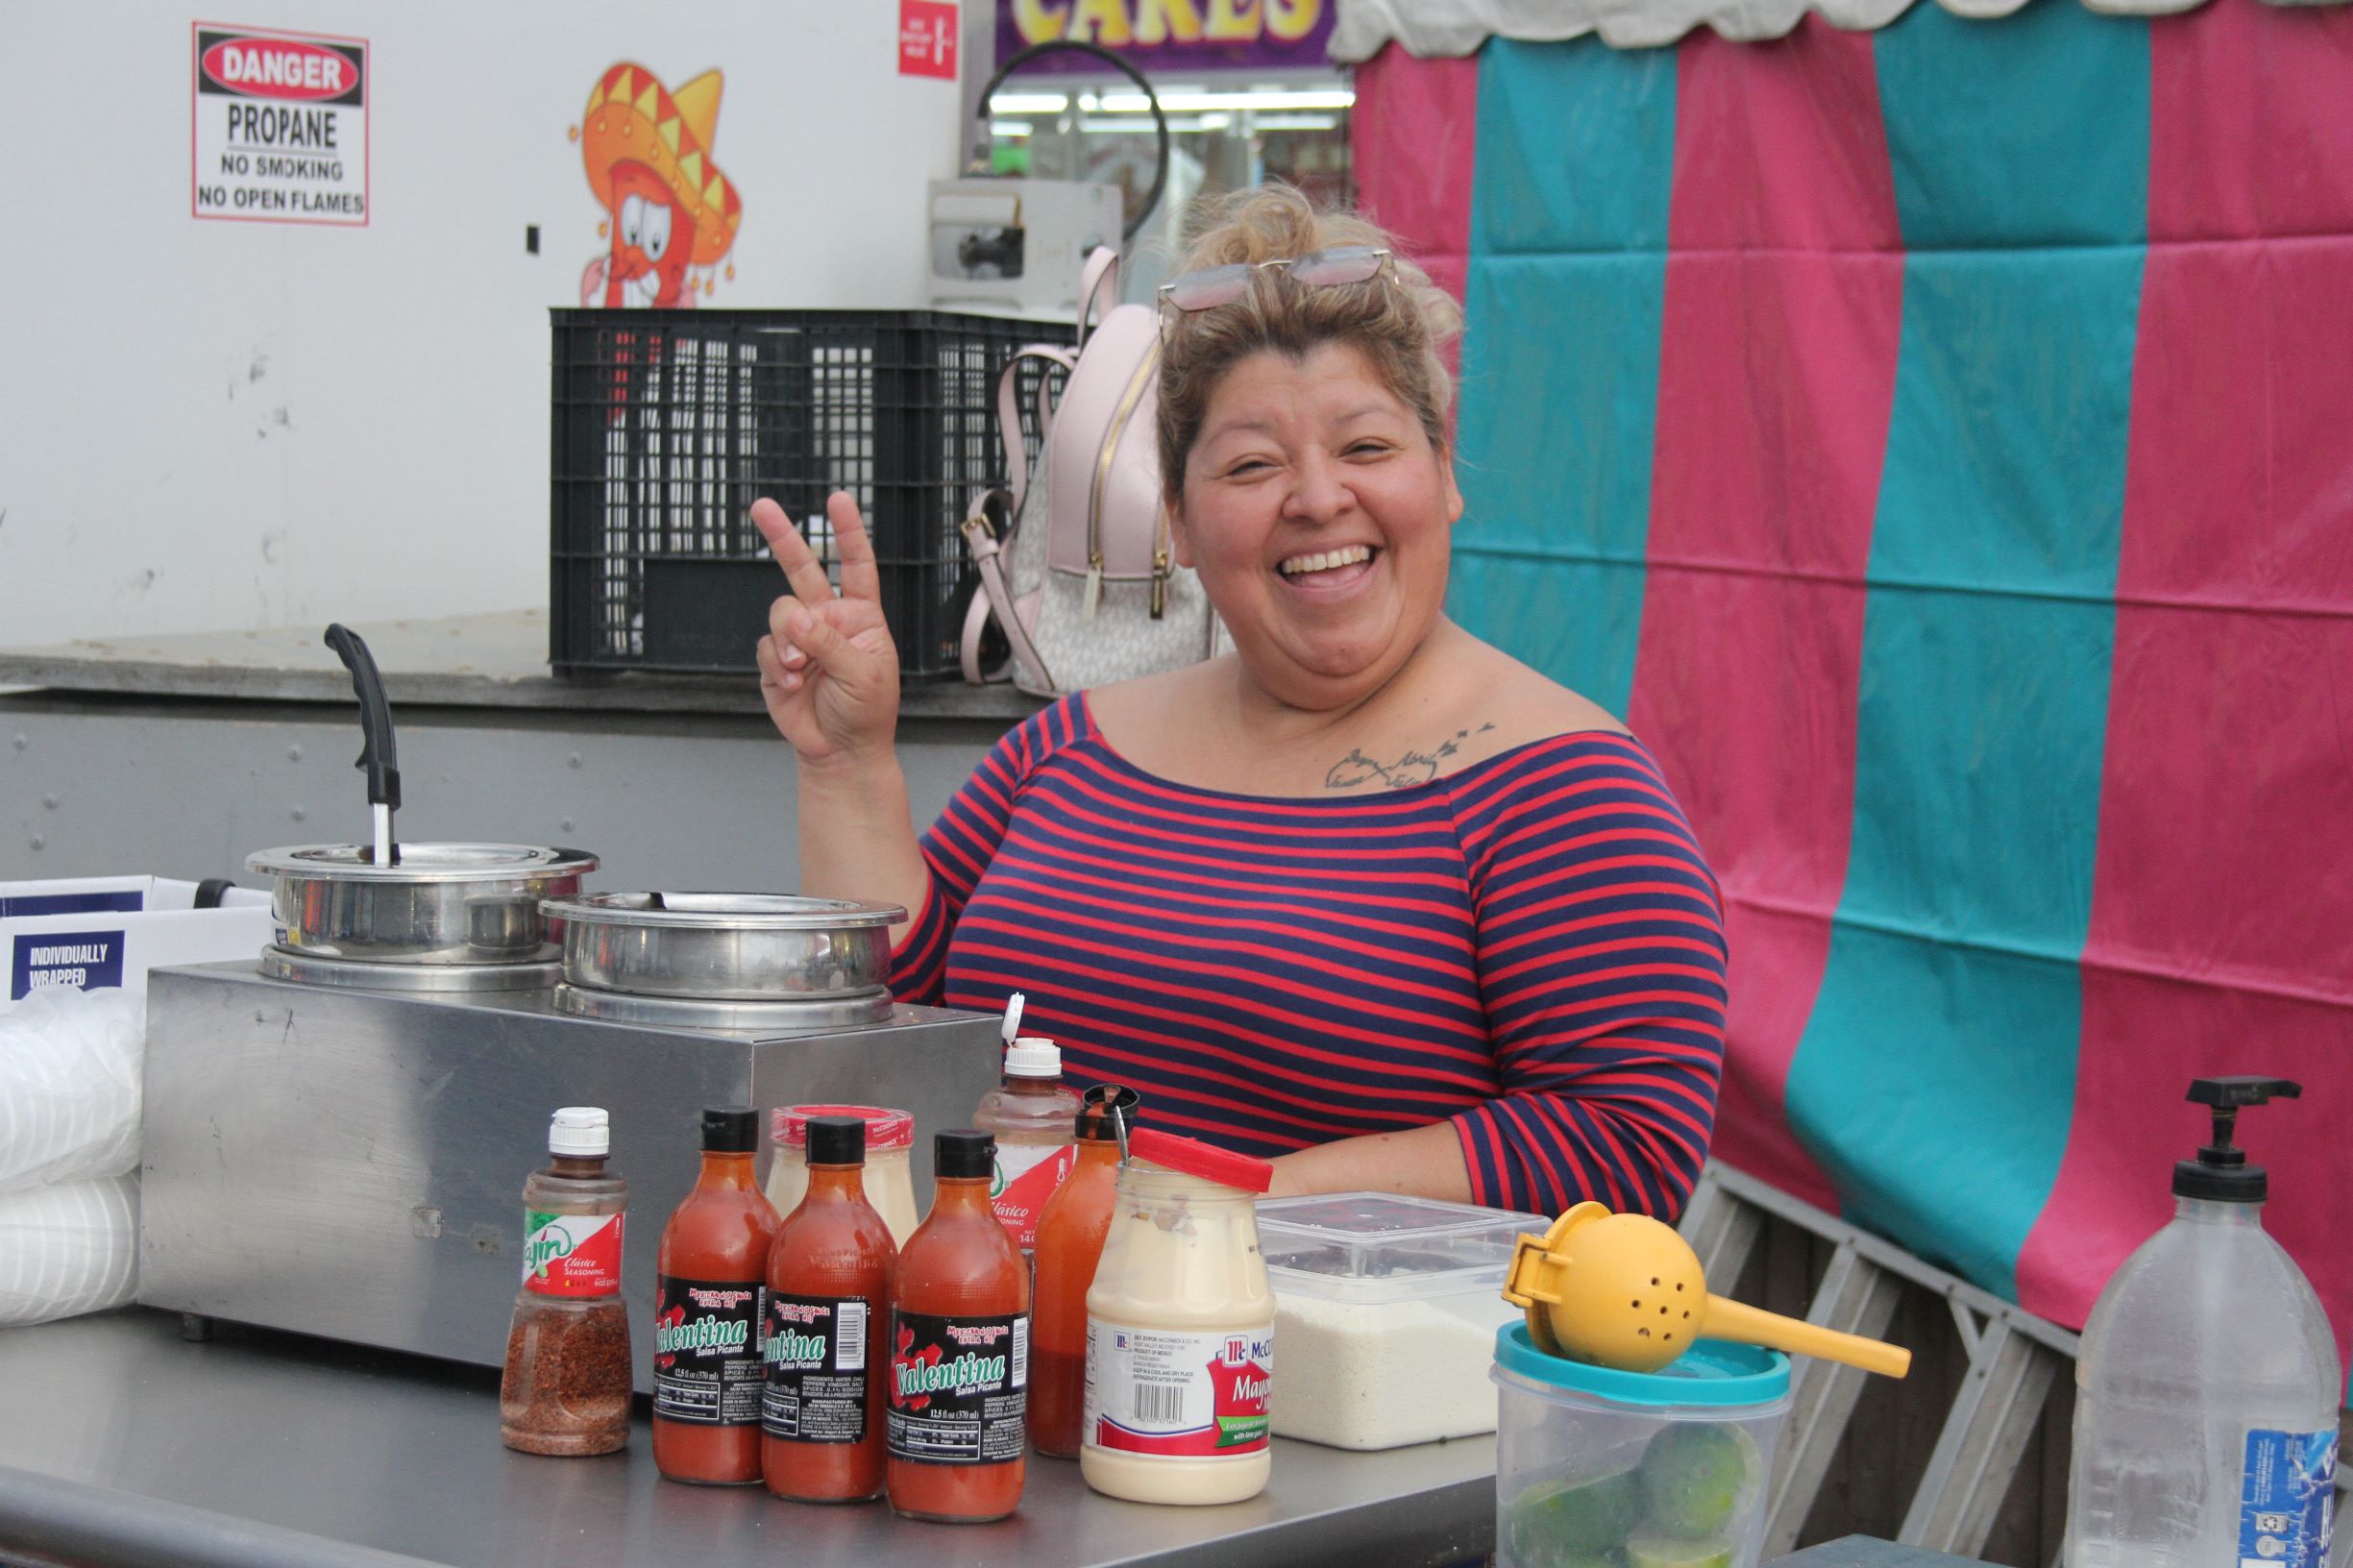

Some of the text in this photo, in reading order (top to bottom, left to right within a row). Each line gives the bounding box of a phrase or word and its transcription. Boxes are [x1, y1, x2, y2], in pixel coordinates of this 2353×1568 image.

[222, 45, 343, 90] DANGER
[228, 103, 338, 148] PROPANE
[221, 153, 344, 182] NO SMOKING
[198, 184, 364, 214] NO OPEN FLAMES
[30, 943, 109, 967] INDIVIDUALLY
[29, 968, 87, 988] WRAPPED
[991, 1201, 1029, 1217] lásico
[998, 1217, 1024, 1226] ONING
[696, 1344, 744, 1357] Salsa Picante
[779, 1360, 821, 1370] Salsa Picante
[895, 1351, 1005, 1395] Valentina
[955, 1382, 1002, 1396] Salsa Picante
[930, 1409, 943, 1418] 12.5
[955, 1409, 968, 1419] (370
